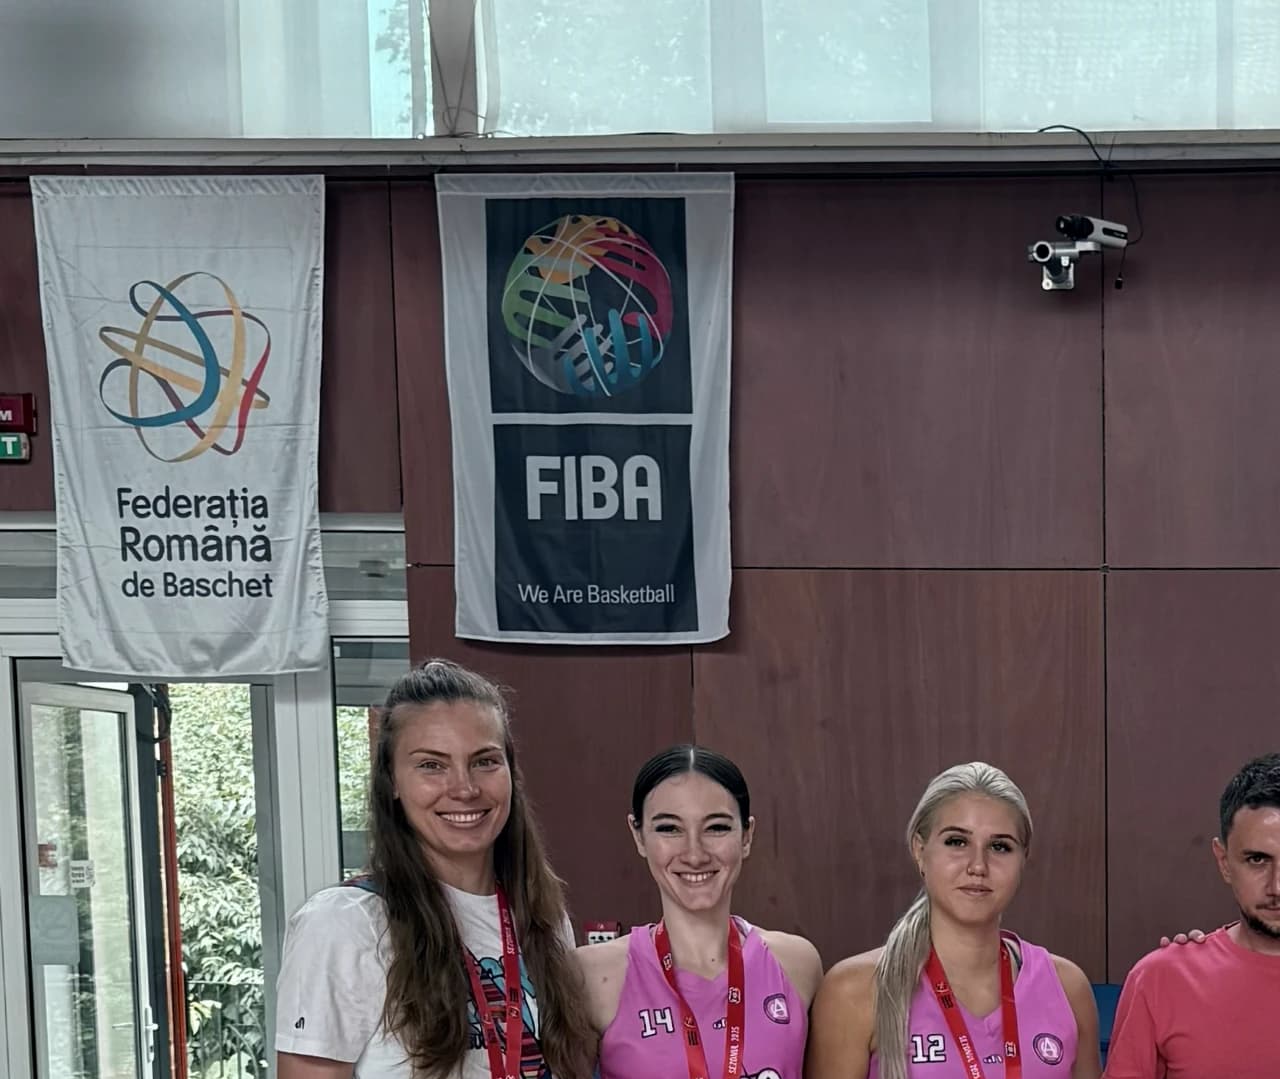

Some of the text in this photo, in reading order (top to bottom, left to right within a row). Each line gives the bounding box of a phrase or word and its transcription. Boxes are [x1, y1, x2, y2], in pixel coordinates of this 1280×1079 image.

[526, 454, 662, 521] FIBA
[117, 485, 269, 528] Federația
[120, 524, 272, 562] Română
[121, 570, 273, 598] de Baschet
[518, 583, 675, 604] We Are Basketball
[639, 1007, 675, 1038] 14
[911, 1034, 947, 1063] 12
